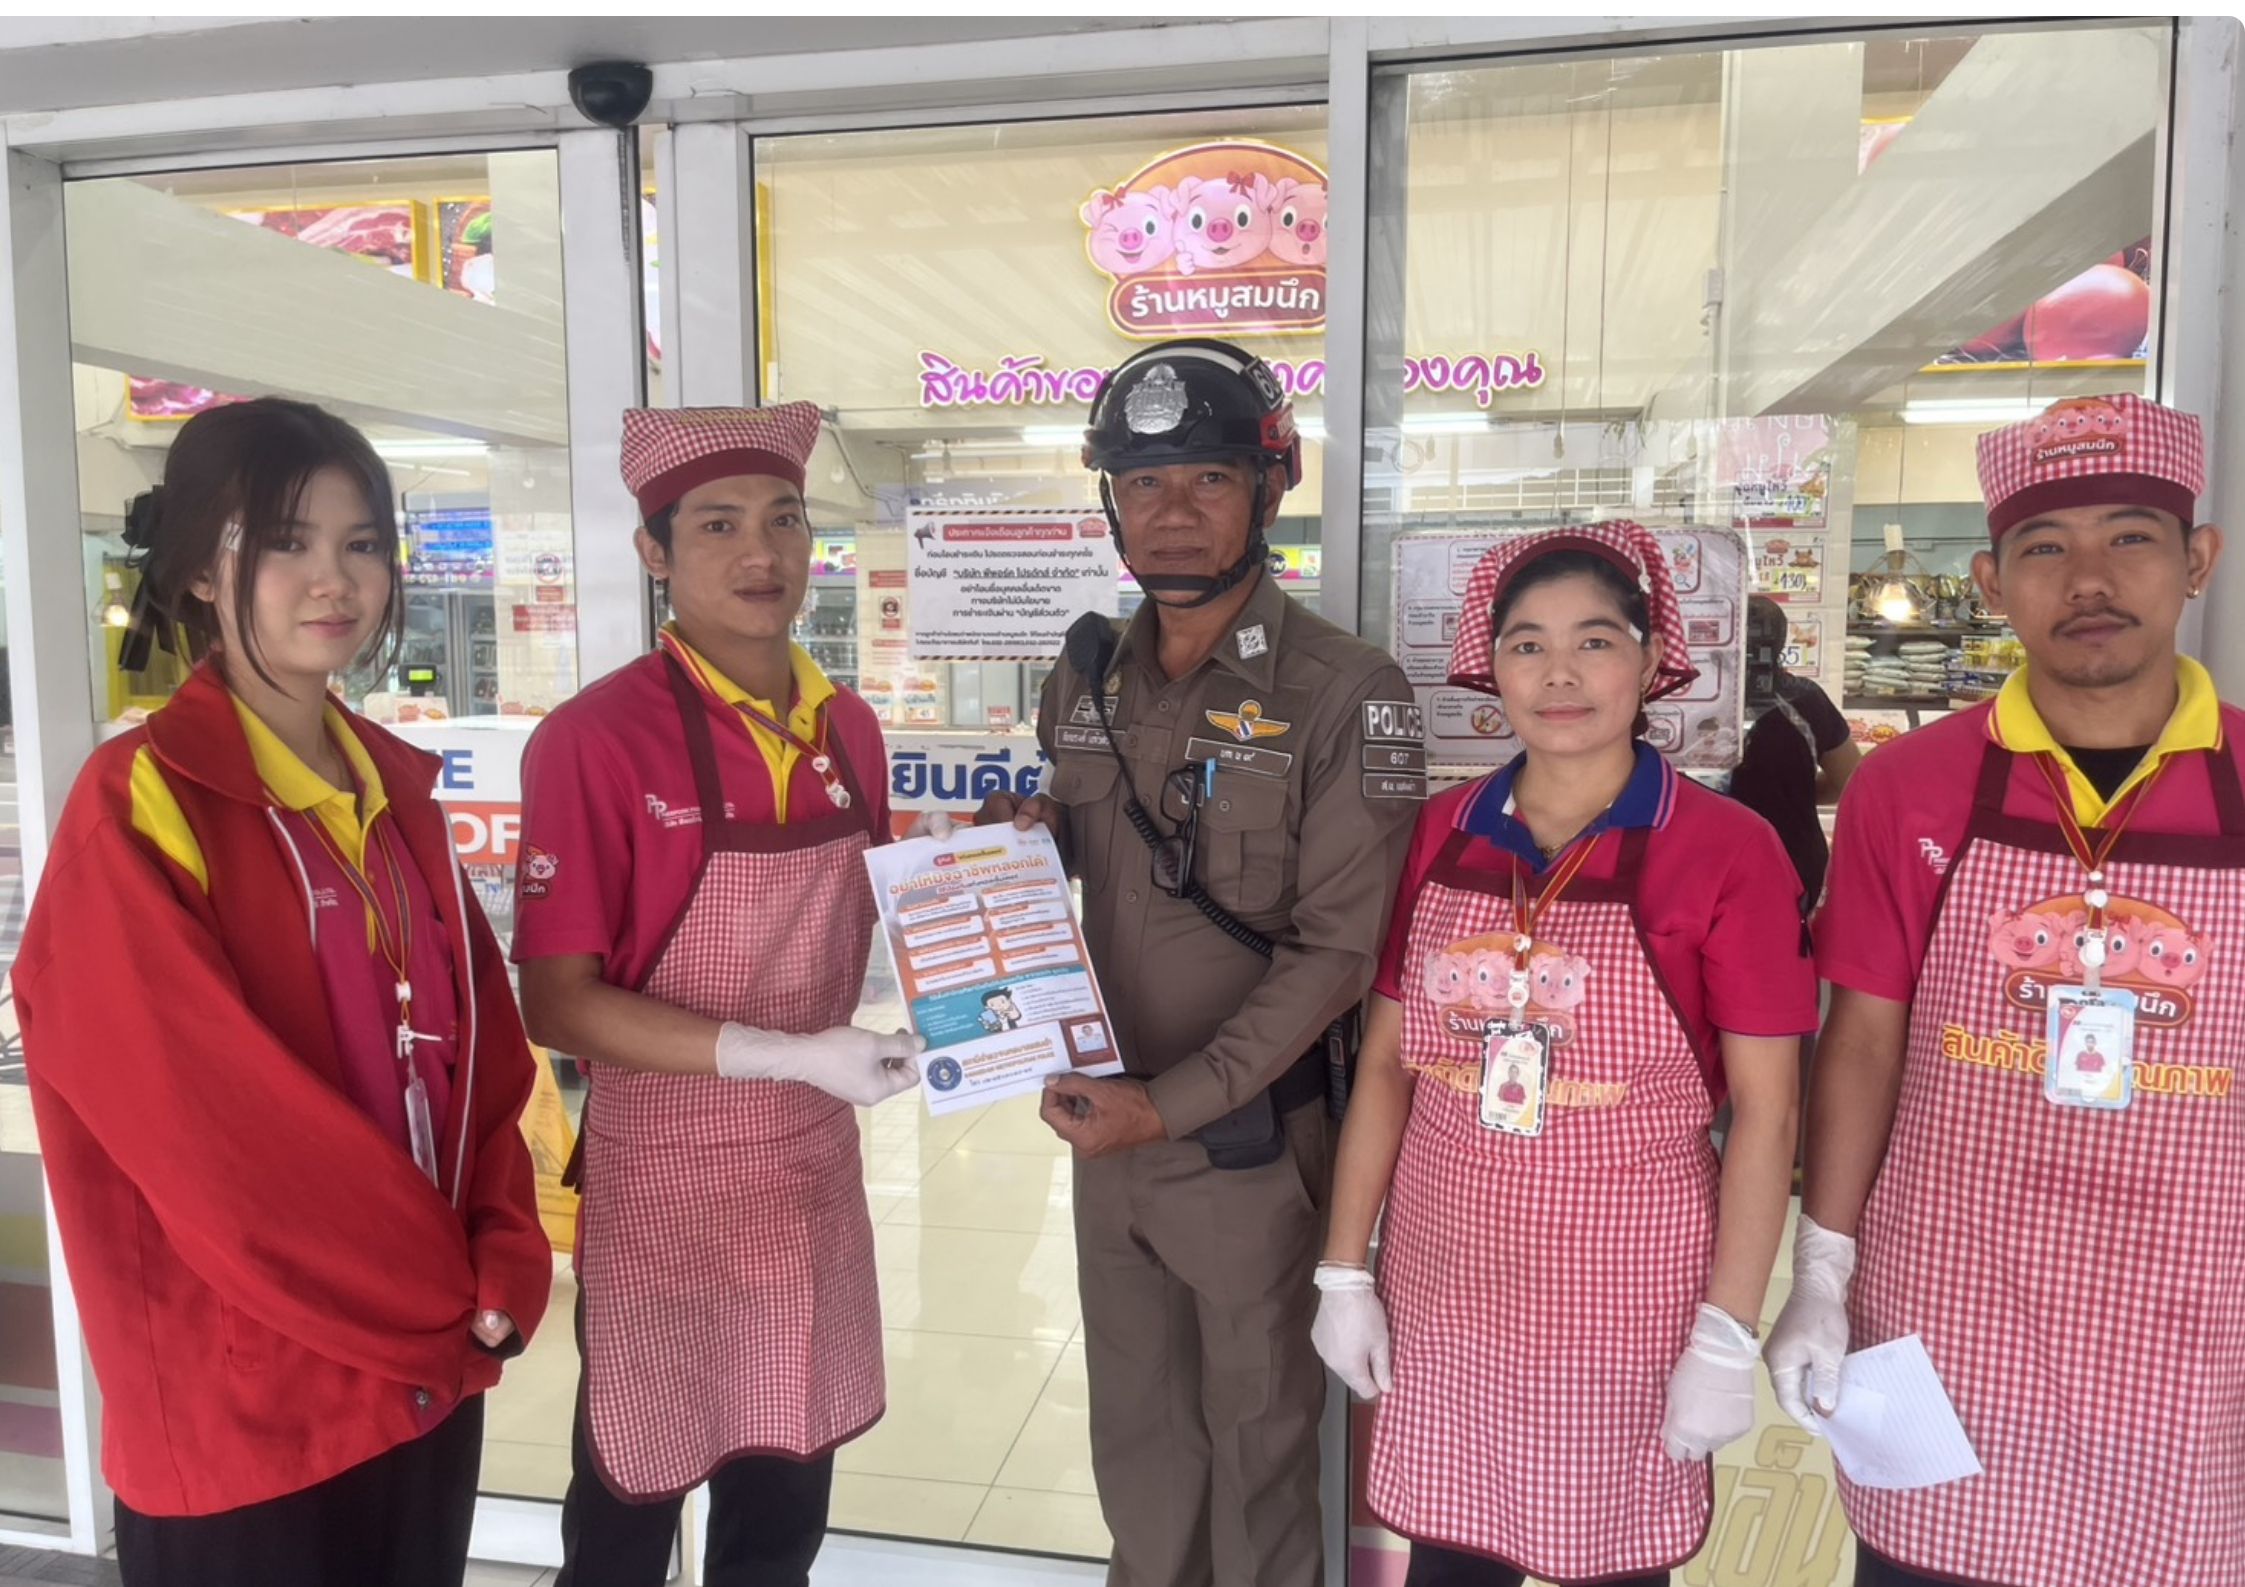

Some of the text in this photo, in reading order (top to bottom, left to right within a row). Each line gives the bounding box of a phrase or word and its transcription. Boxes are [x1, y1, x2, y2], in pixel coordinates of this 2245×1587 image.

[1130, 277, 1320, 319] ร้านหมูสมนึก
[2035, 438, 2116, 460] ร้านหมูสมนึก
[914, 565, 947, 579] ชื่อบัญชี
[1081, 564, 1109, 578] เท่านั้น
[1366, 705, 1424, 738] POLICE
[1390, 752, 1410, 765] 607
